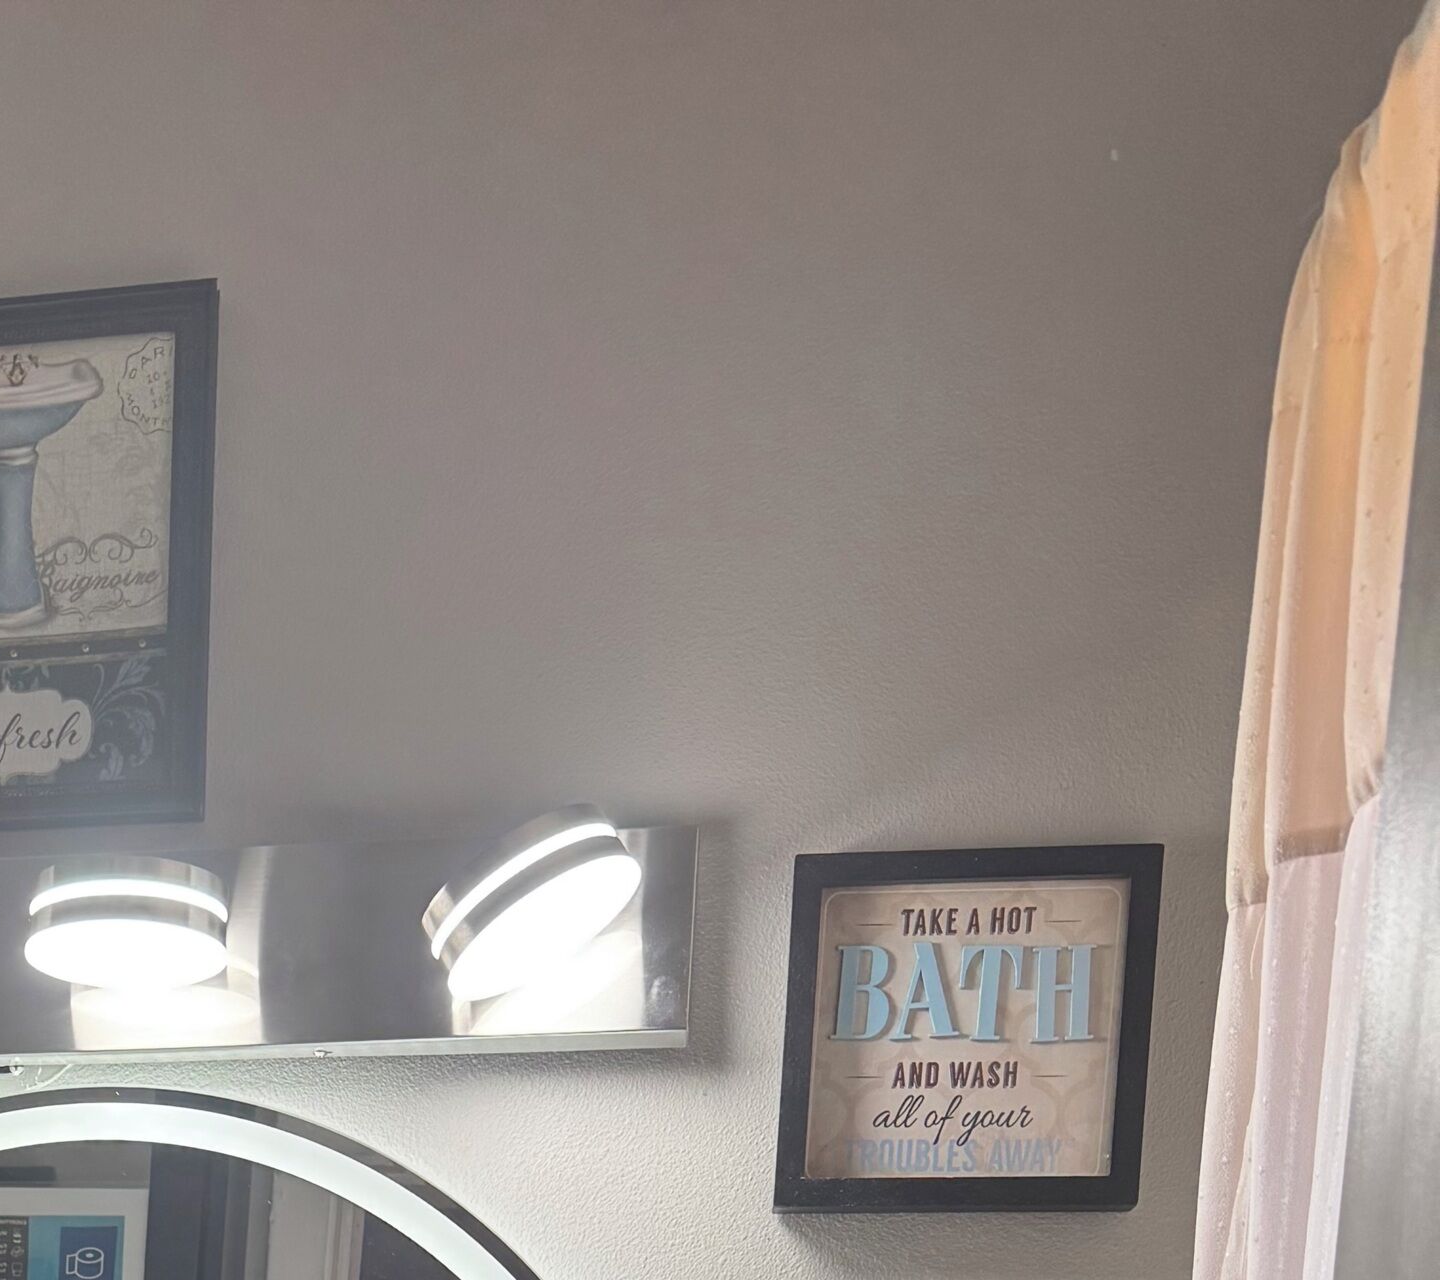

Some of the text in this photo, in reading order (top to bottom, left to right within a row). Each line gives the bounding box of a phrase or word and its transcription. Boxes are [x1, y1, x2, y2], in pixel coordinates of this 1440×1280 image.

[901, 906, 1037, 936] TAKE A HOT
[828, 941, 1097, 1043] BATH
[891, 1061, 1019, 1089] AND WASH
[872, 1095, 1034, 1146] all of your
[844, 1138, 1061, 1172] TROUBLES AWAY
